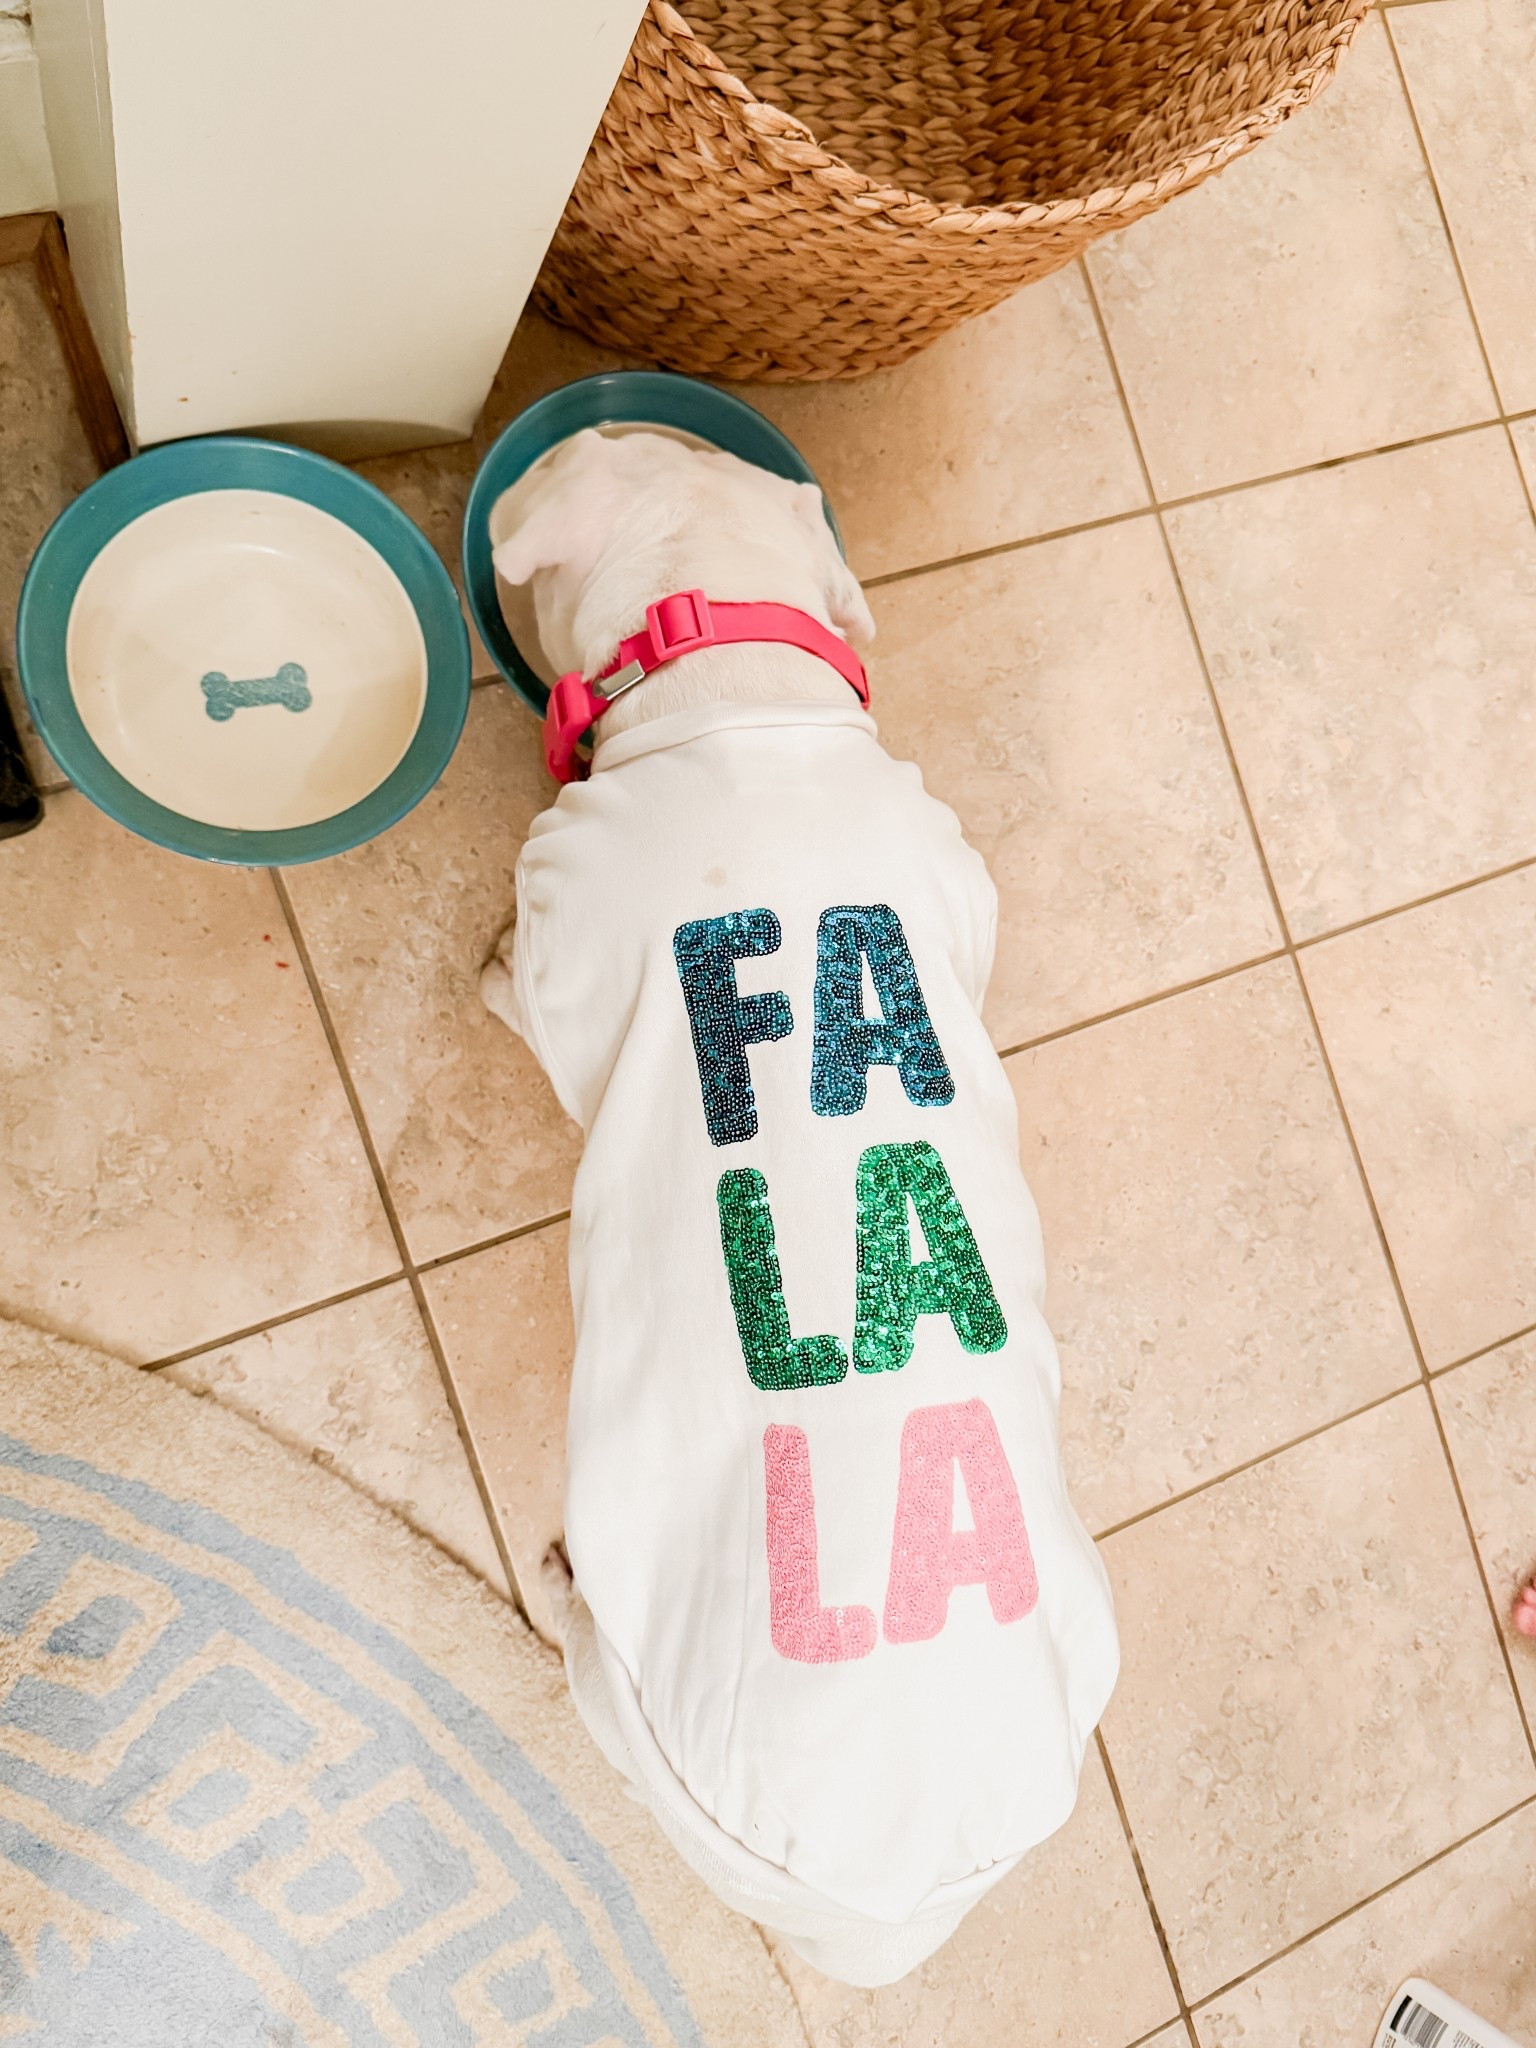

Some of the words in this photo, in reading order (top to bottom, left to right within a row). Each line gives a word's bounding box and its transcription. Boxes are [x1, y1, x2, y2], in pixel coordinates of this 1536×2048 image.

[673, 904, 956, 1147] FA
[716, 1140, 1008, 1392] LA
[763, 1397, 1039, 1664] LA
